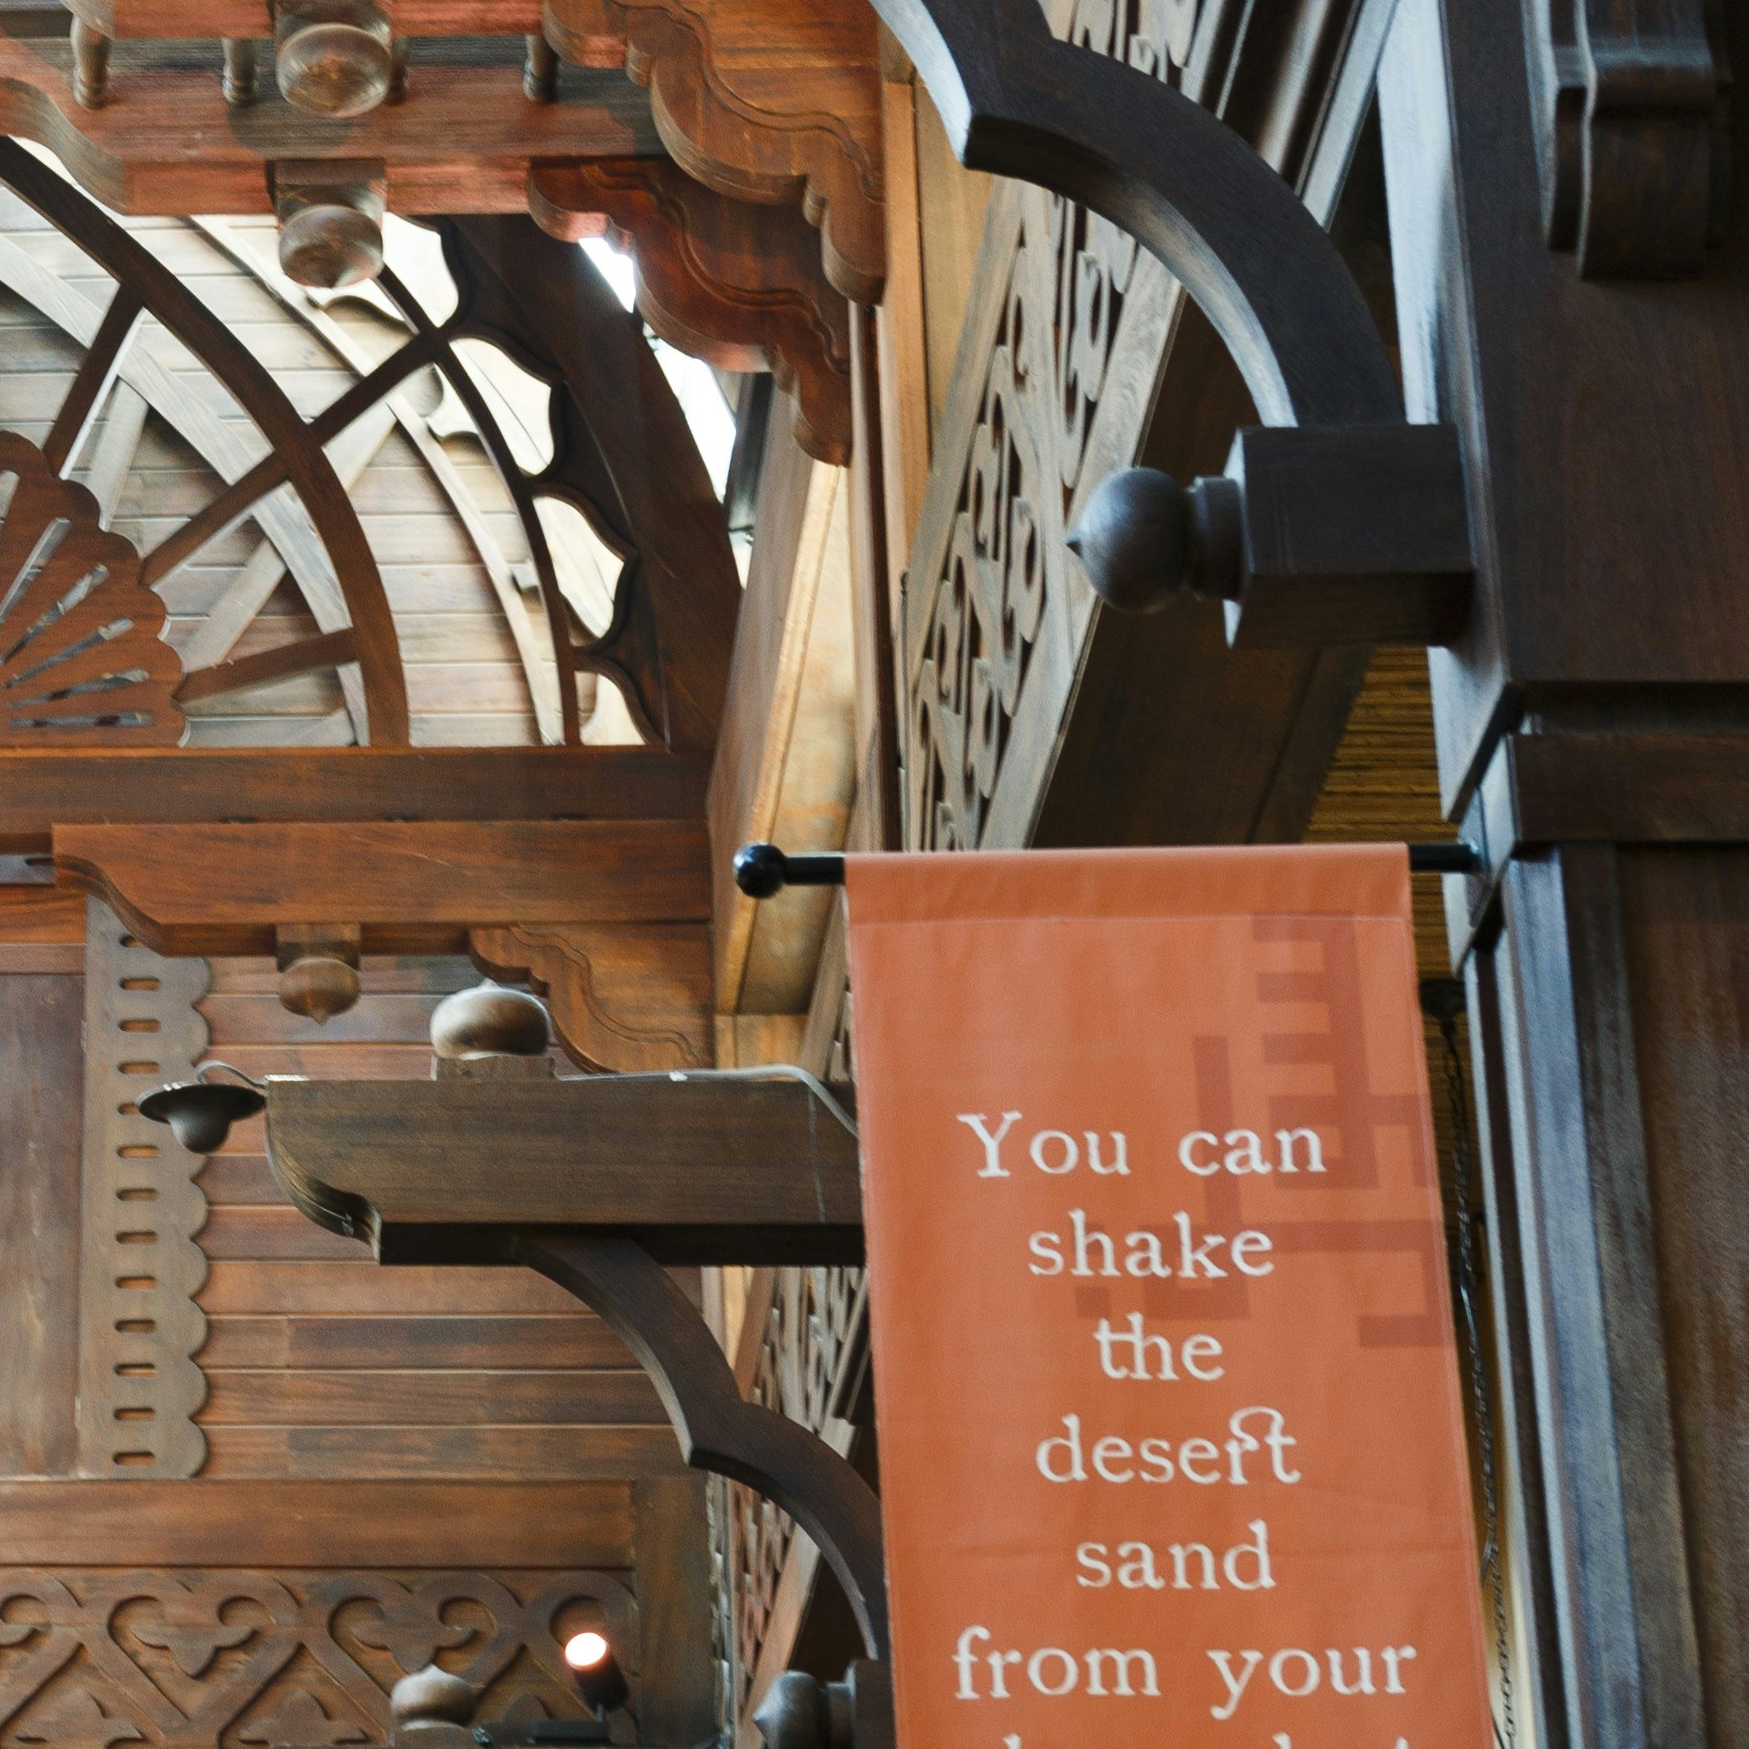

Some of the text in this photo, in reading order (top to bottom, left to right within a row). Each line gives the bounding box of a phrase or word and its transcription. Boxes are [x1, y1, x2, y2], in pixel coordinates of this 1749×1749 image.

[956, 1110, 1327, 1179] You can
[1028, 1208, 1275, 1279] shake
[1093, 1311, 1225, 1381] the
[1035, 1406, 1301, 1486] desert
[1076, 1519, 1276, 1590] sand
[952, 1625, 1417, 1720] from your
